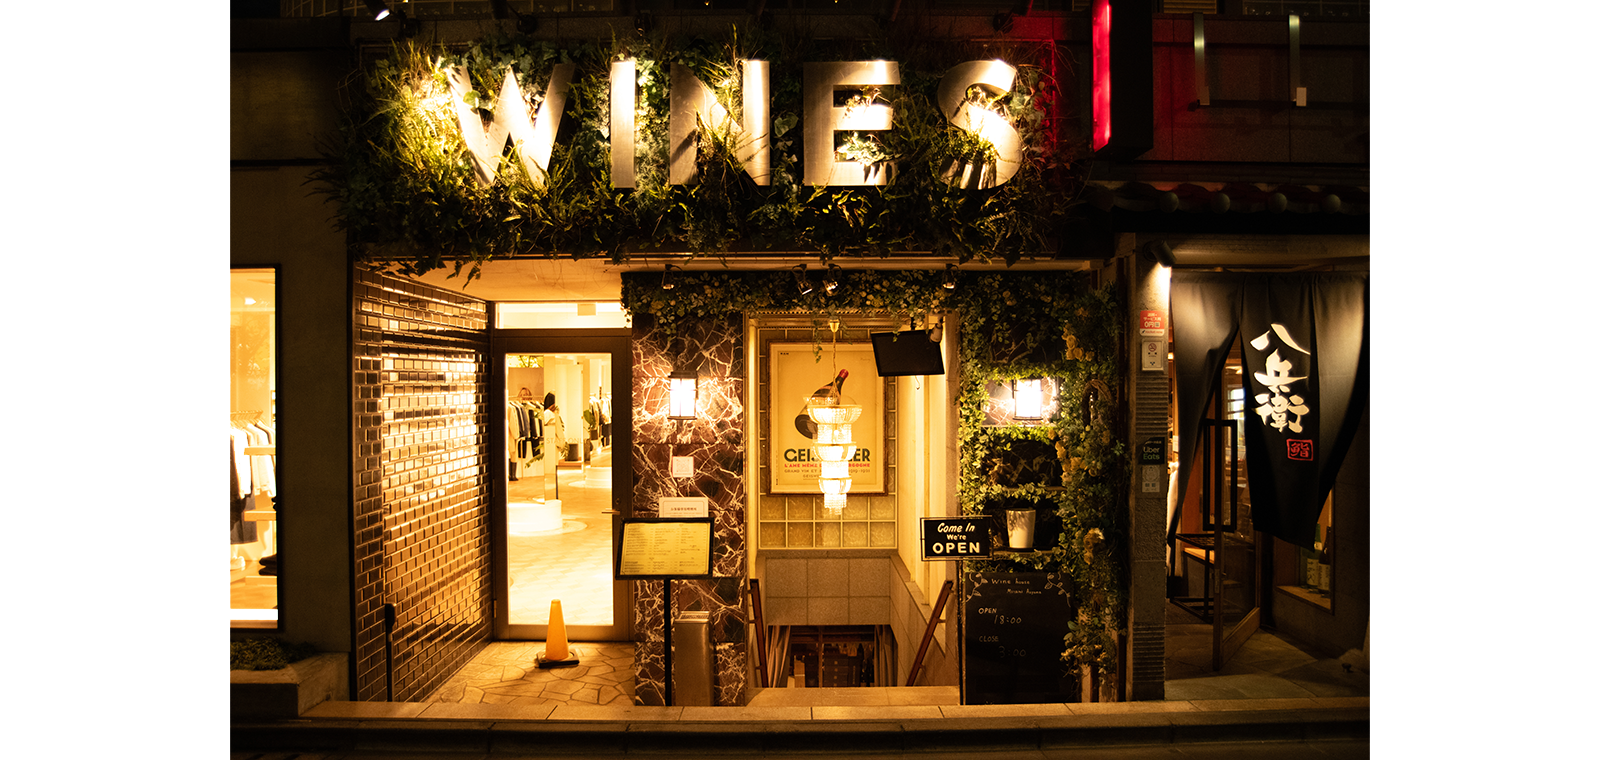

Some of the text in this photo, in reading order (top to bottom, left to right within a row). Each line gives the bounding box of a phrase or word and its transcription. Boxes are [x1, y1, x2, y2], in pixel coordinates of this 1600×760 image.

[446, 58, 1023, 190] WINES
[1250, 323, 1311, 433] 八兵衛
[1290, 443, 1310, 458] 鮨
[937, 522, 976, 533] Come In
[946, 533, 967, 541] We're
[932, 542, 980, 554] OPEN
[978, 607, 997, 615] OPEN
[993, 614, 1022, 625] 18:00
[978, 635, 999, 643] CLOSE
[998, 645, 1027, 658] 3:00
